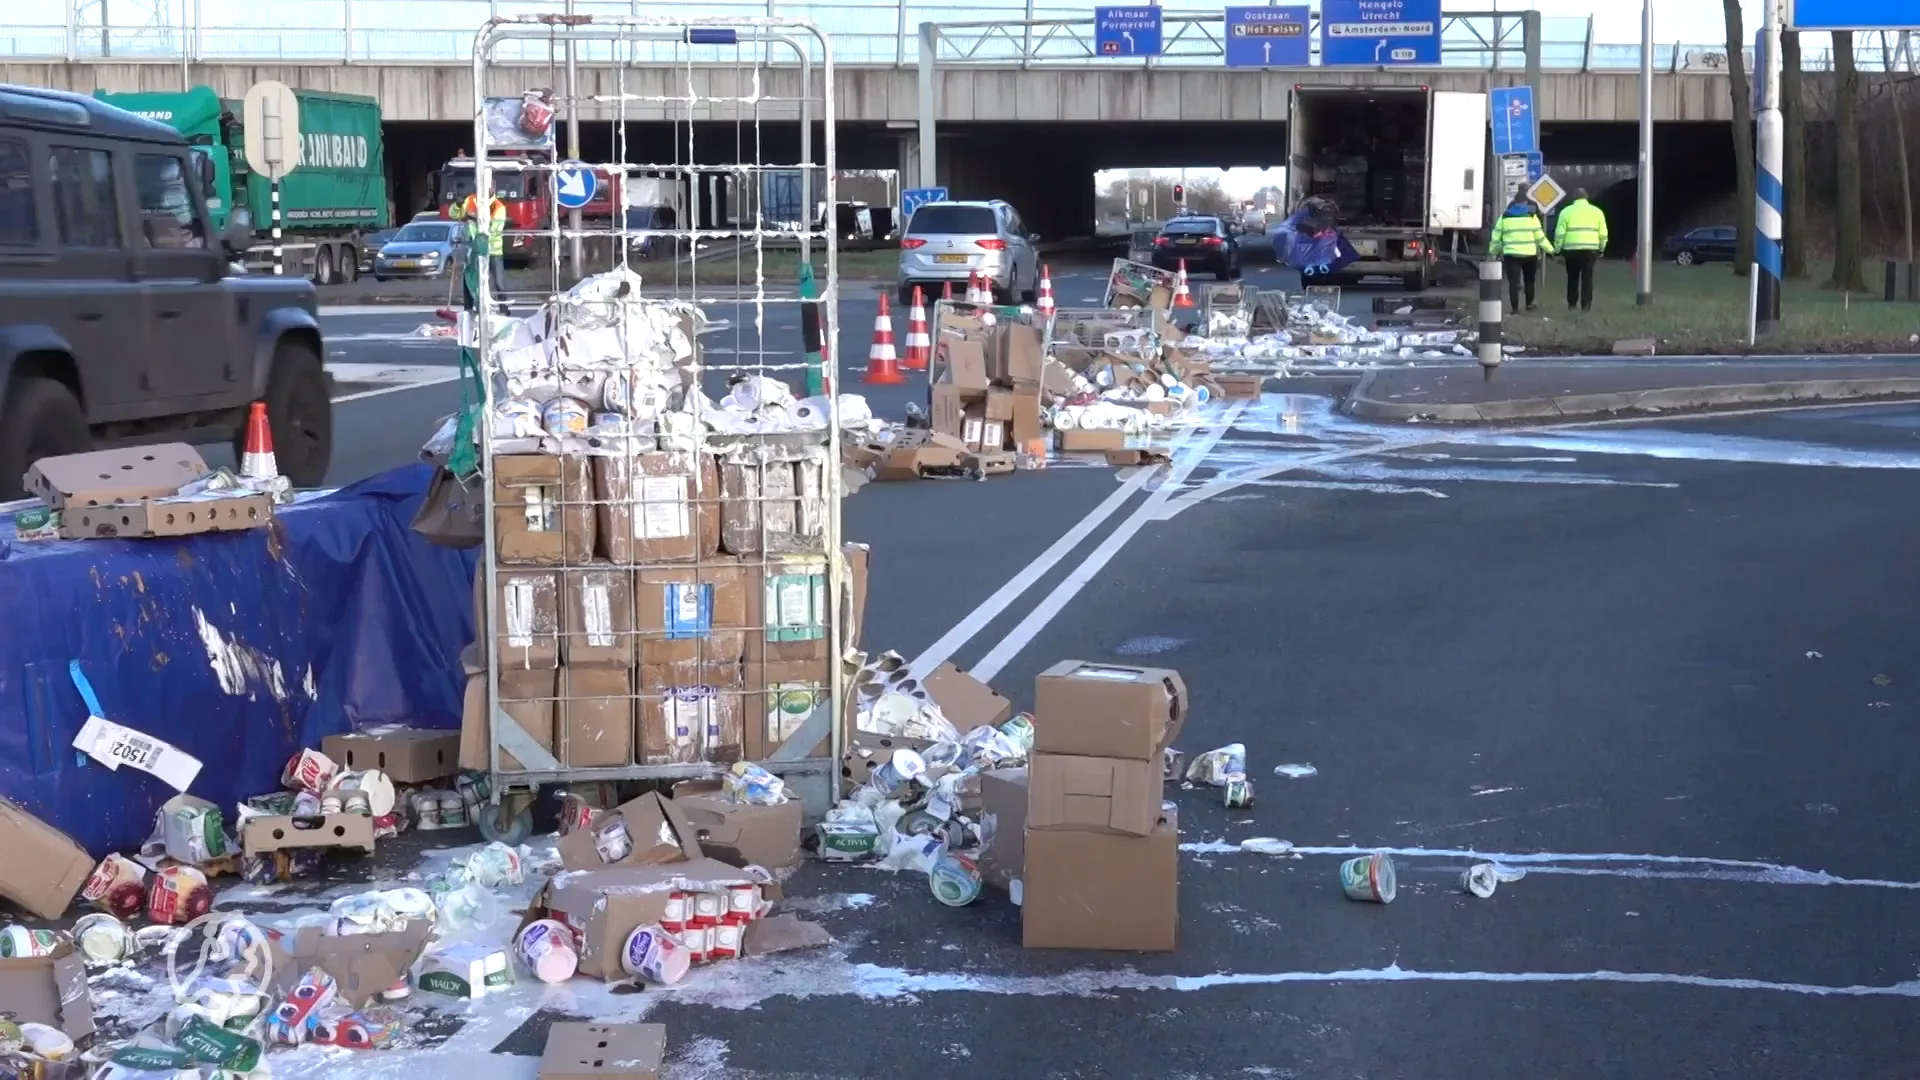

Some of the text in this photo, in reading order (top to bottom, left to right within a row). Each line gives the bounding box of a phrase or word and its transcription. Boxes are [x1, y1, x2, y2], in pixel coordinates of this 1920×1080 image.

[1359, 0, 1403, 10] Hengelo
[1107, 10, 1149, 18] Alkmaar
[1361, 11, 1400, 20] Utrecht
[1101, 20, 1156, 29] Purmerend
[183, 1035, 222, 1059] ACTIVIA
